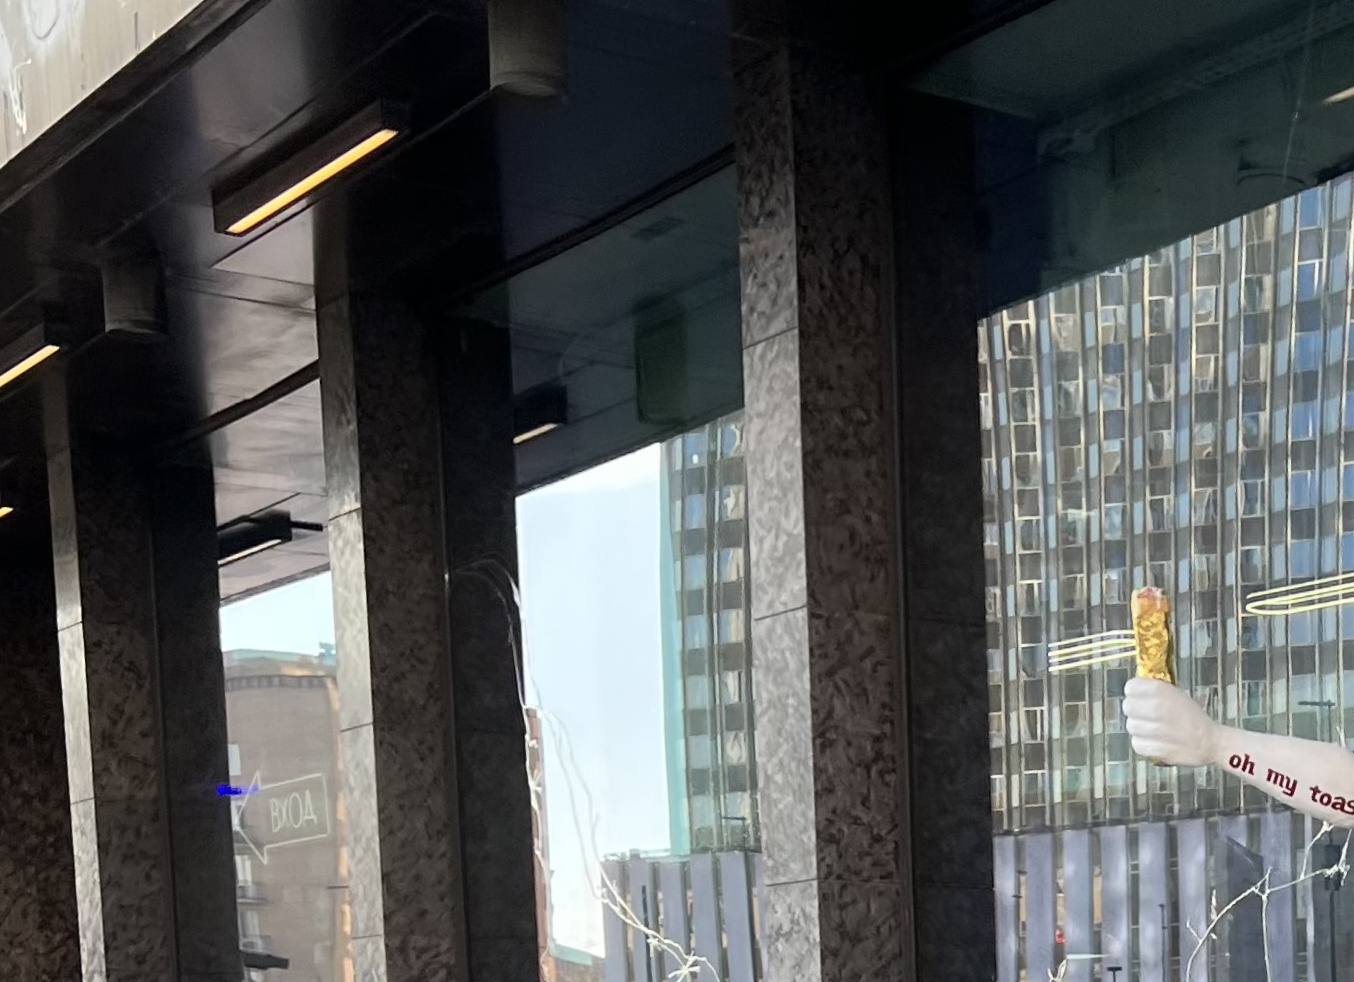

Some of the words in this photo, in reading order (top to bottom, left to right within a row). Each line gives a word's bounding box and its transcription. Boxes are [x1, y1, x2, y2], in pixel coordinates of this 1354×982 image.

[1229, 753, 1255, 775] oh
[1266, 768, 1298, 797] my
[270, 789, 317, 833] ВХОД
